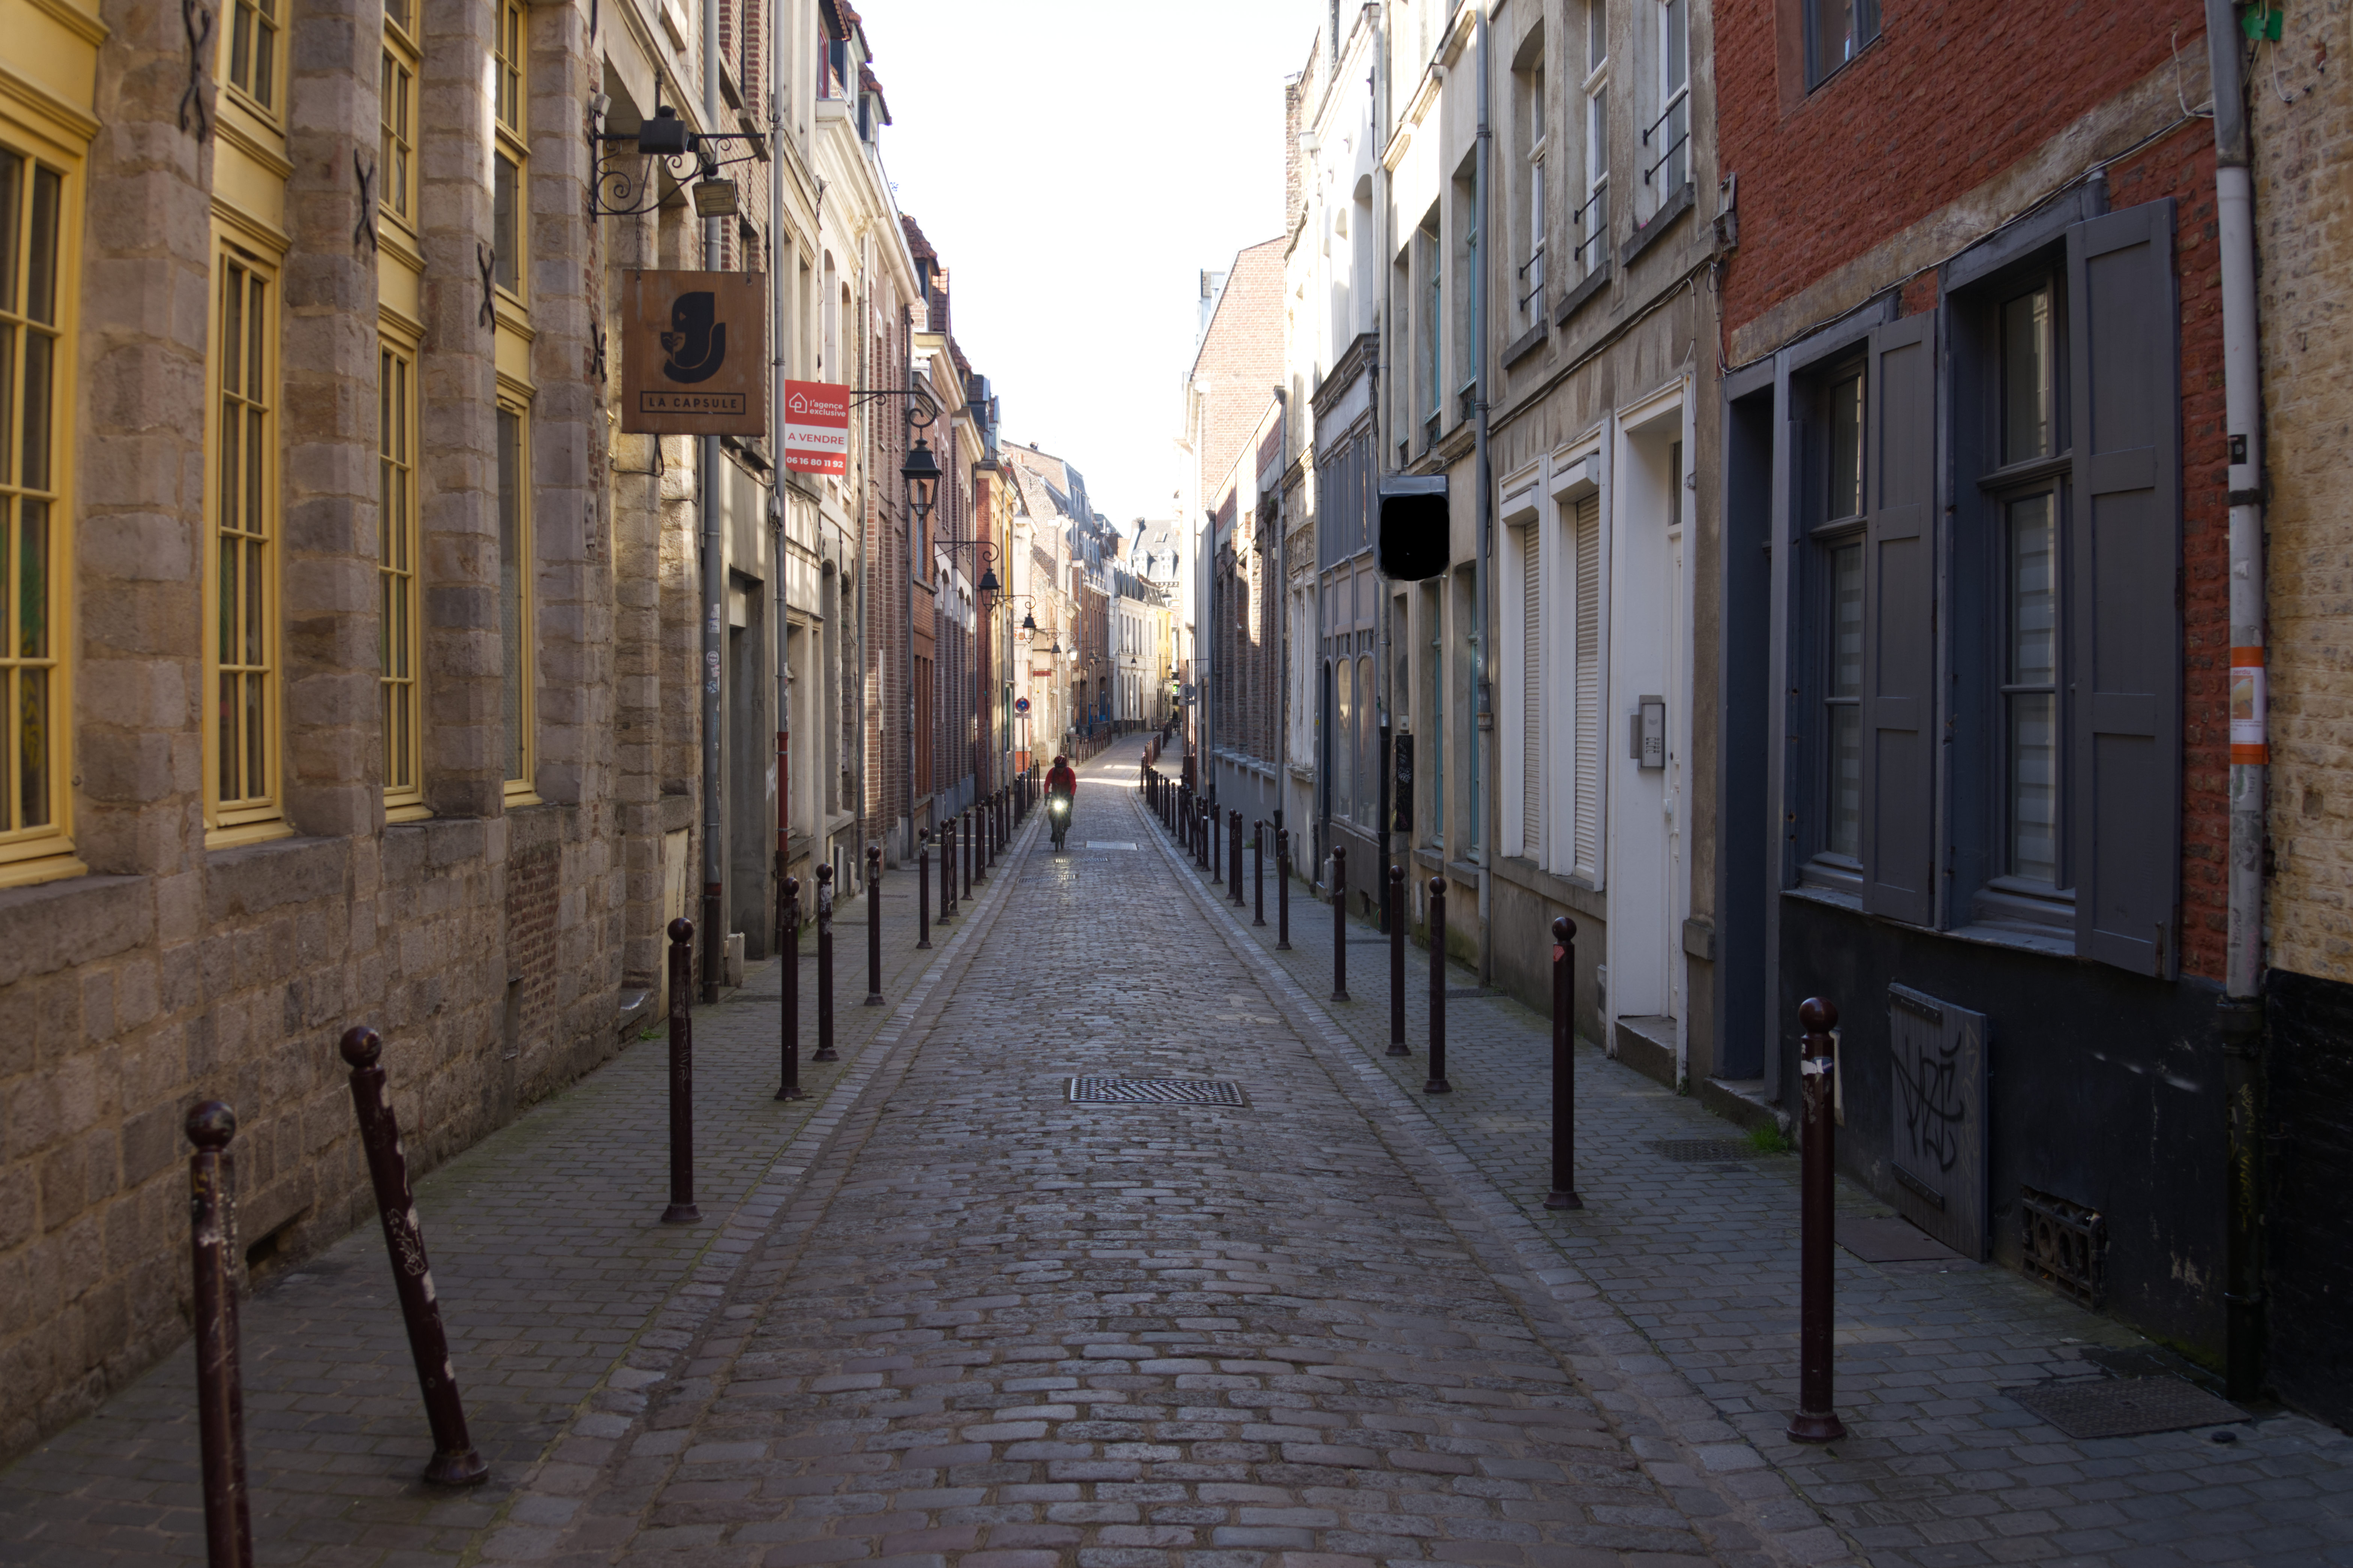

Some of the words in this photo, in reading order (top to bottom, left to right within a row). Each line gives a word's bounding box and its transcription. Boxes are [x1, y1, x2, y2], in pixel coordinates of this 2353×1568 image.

[649, 398, 666, 407] LA
[674, 398, 737, 409] CAPSULE
[810, 408, 846, 417] exclusive
[799, 433, 844, 445] VENDRE
